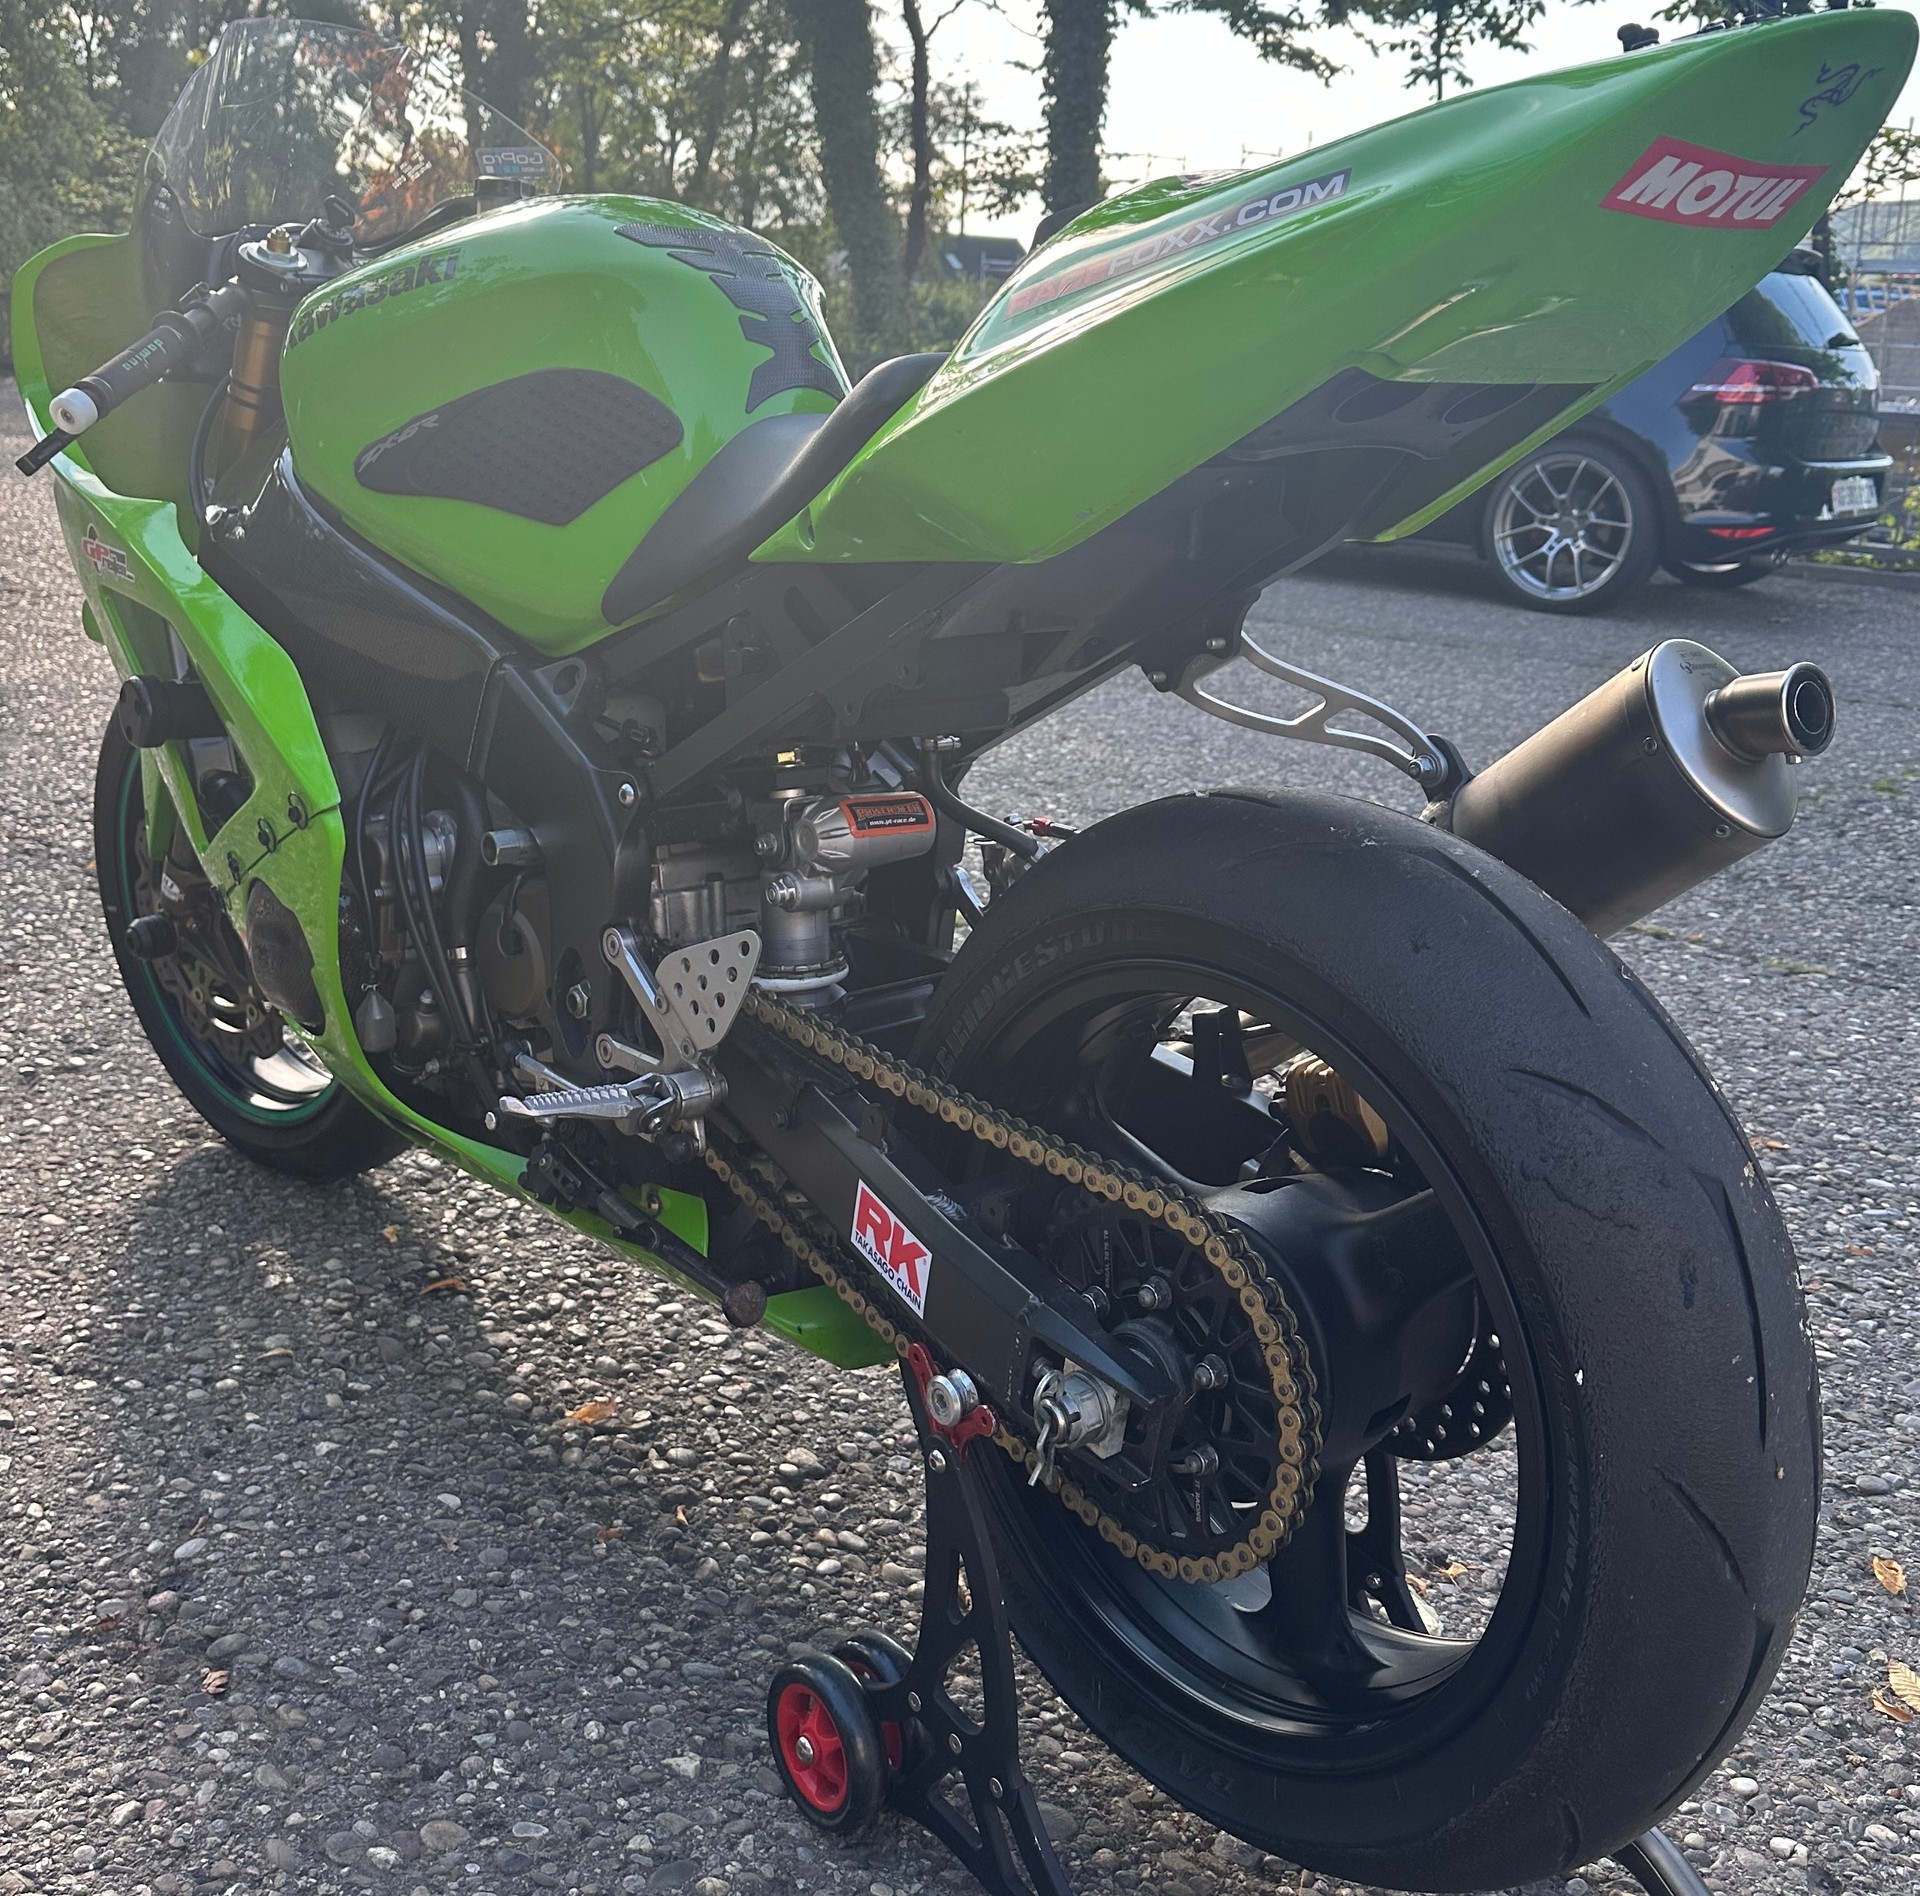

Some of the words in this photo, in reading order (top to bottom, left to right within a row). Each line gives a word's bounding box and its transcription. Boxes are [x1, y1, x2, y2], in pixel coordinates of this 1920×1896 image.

[1616, 154, 1807, 221] MOTUL
[854, 1230, 896, 1281] TAKASAGO
[896, 1278, 922, 1311] CHAIN
[856, 1186, 928, 1299] RK
